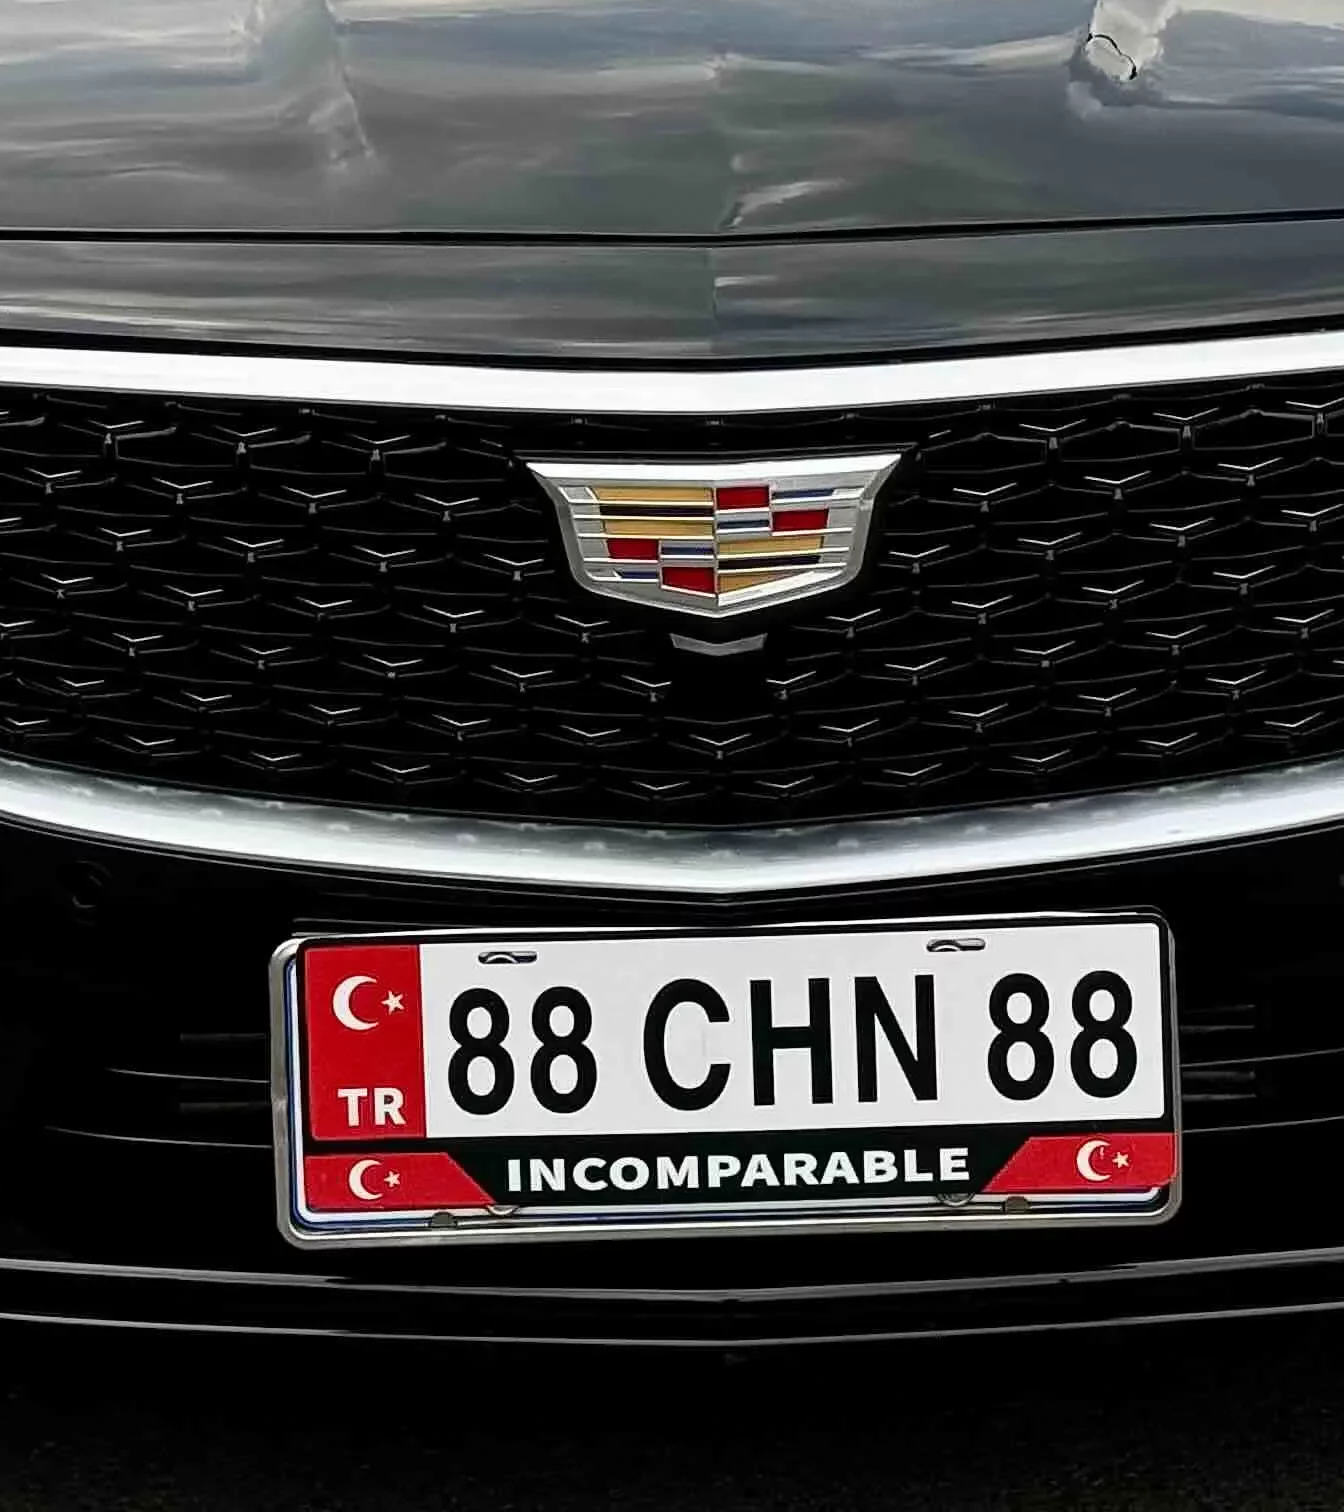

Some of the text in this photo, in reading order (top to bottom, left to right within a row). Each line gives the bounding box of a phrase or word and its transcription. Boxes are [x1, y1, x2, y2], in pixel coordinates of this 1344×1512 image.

[447, 971, 1138, 1115] 88 CHN 88
[338, 1086, 406, 1127] TR
[508, 1147, 970, 1192] INCOMPARABLE
